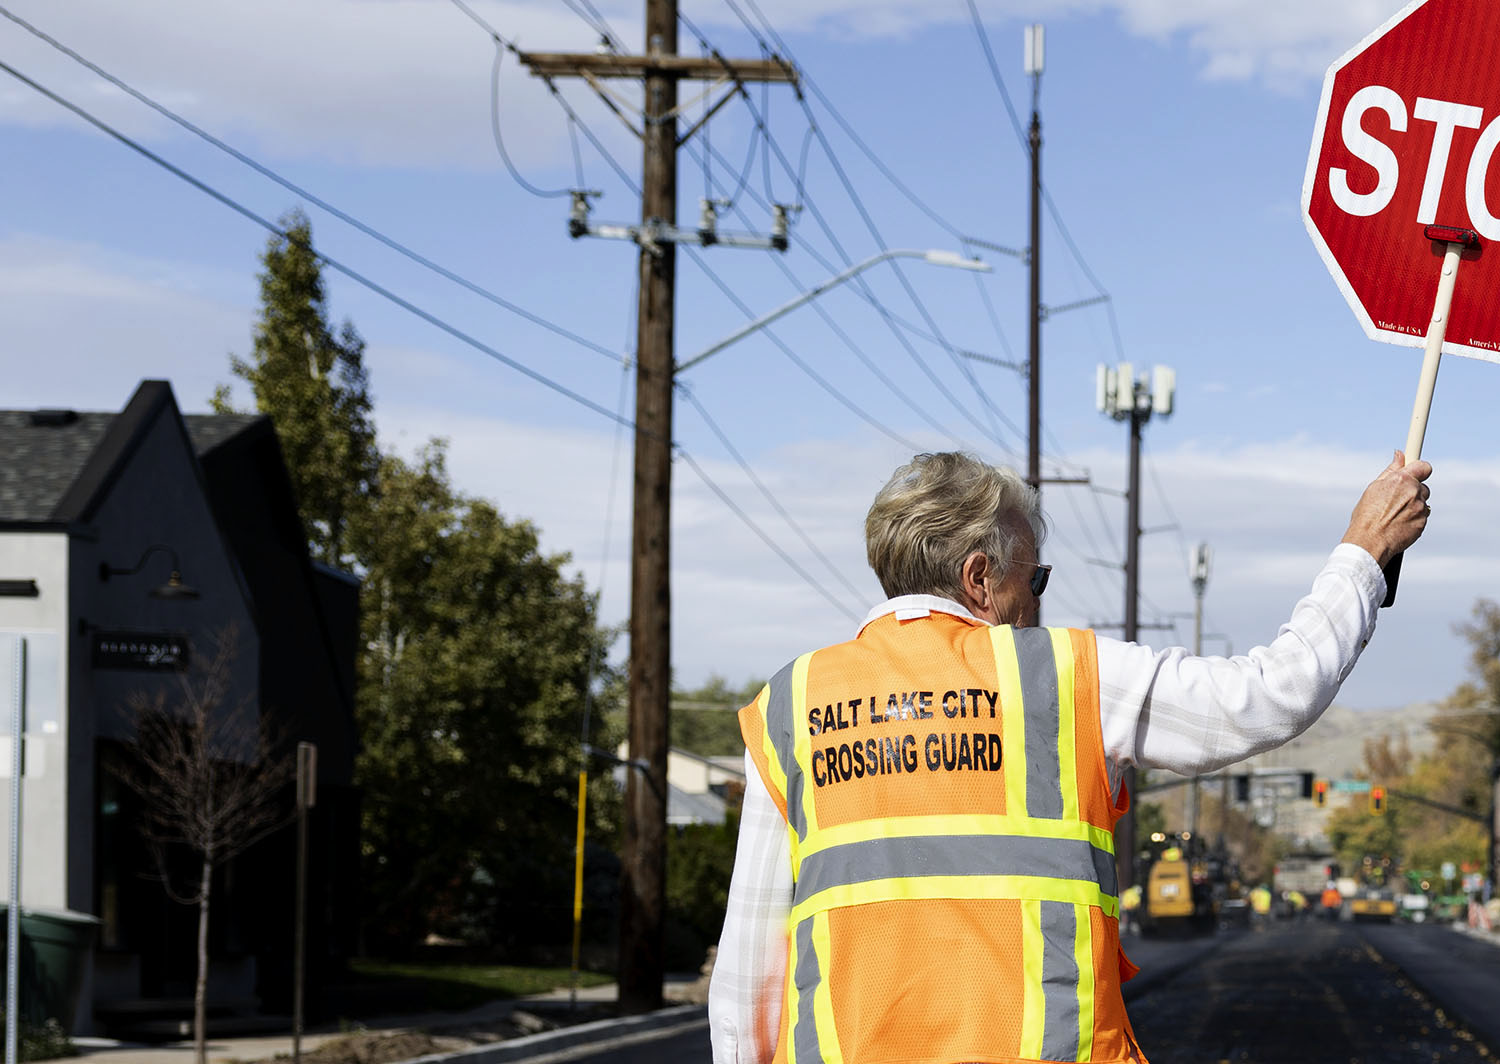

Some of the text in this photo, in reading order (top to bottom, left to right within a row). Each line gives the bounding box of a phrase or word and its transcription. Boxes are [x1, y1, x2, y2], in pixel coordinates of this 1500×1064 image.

[1378, 320, 1422, 336] Made in USA
[808, 689, 998, 736] SALT LAKE CITY
[812, 733, 1001, 787] CROSSING GUARD
